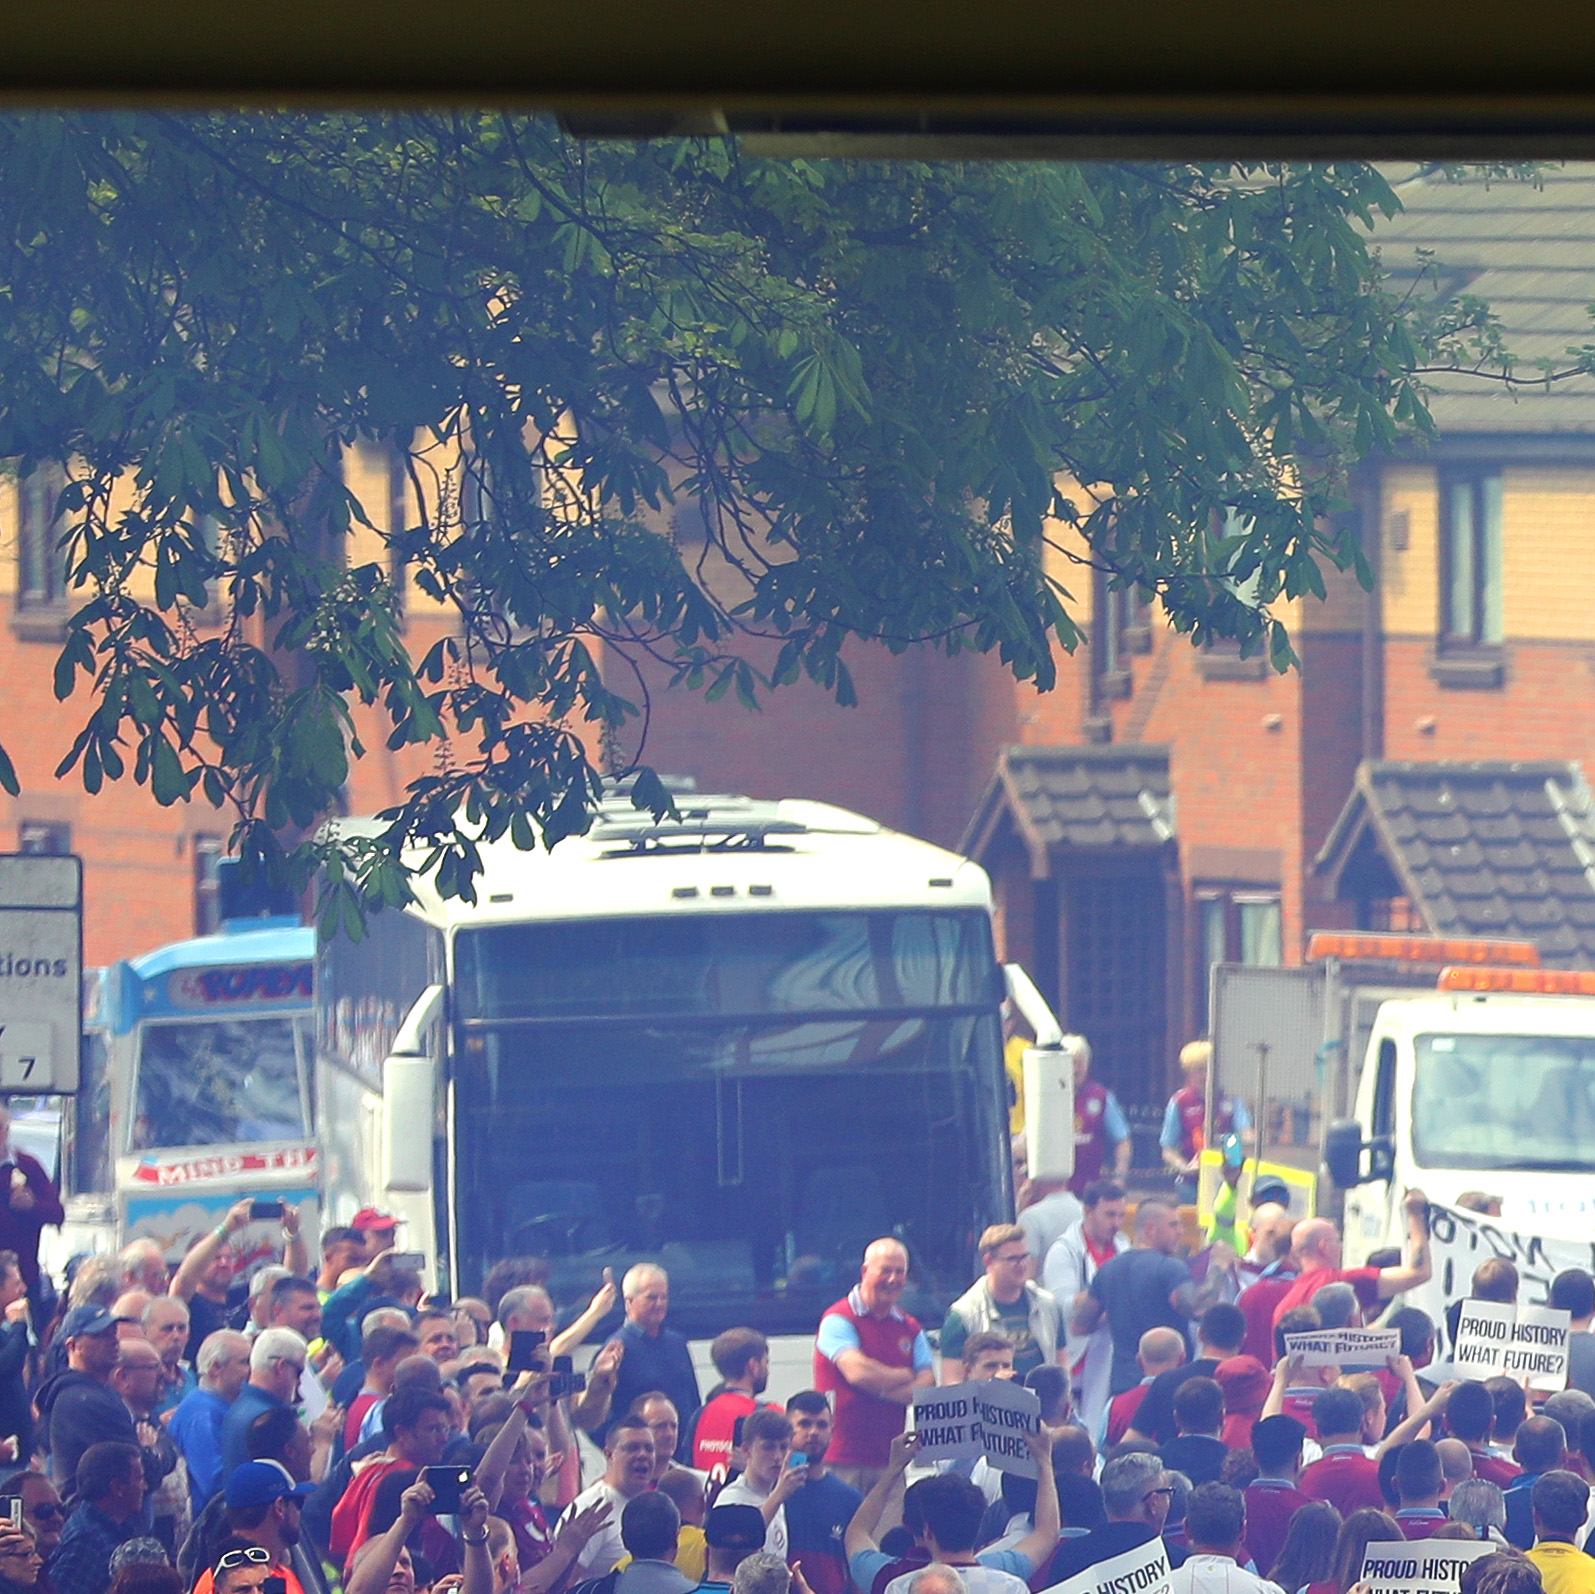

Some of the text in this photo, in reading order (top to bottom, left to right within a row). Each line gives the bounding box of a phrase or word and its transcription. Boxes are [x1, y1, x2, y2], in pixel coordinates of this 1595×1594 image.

[1460, 1317, 1567, 1346] PROUD HISTORY
[1458, 1343, 1564, 1375] WHAT FUTURE?
[915, 1396, 1031, 1433] PROUD HISTORY
[920, 1425, 965, 1447] WHAT
[1363, 1557, 1467, 1581] PROUD HISTO
